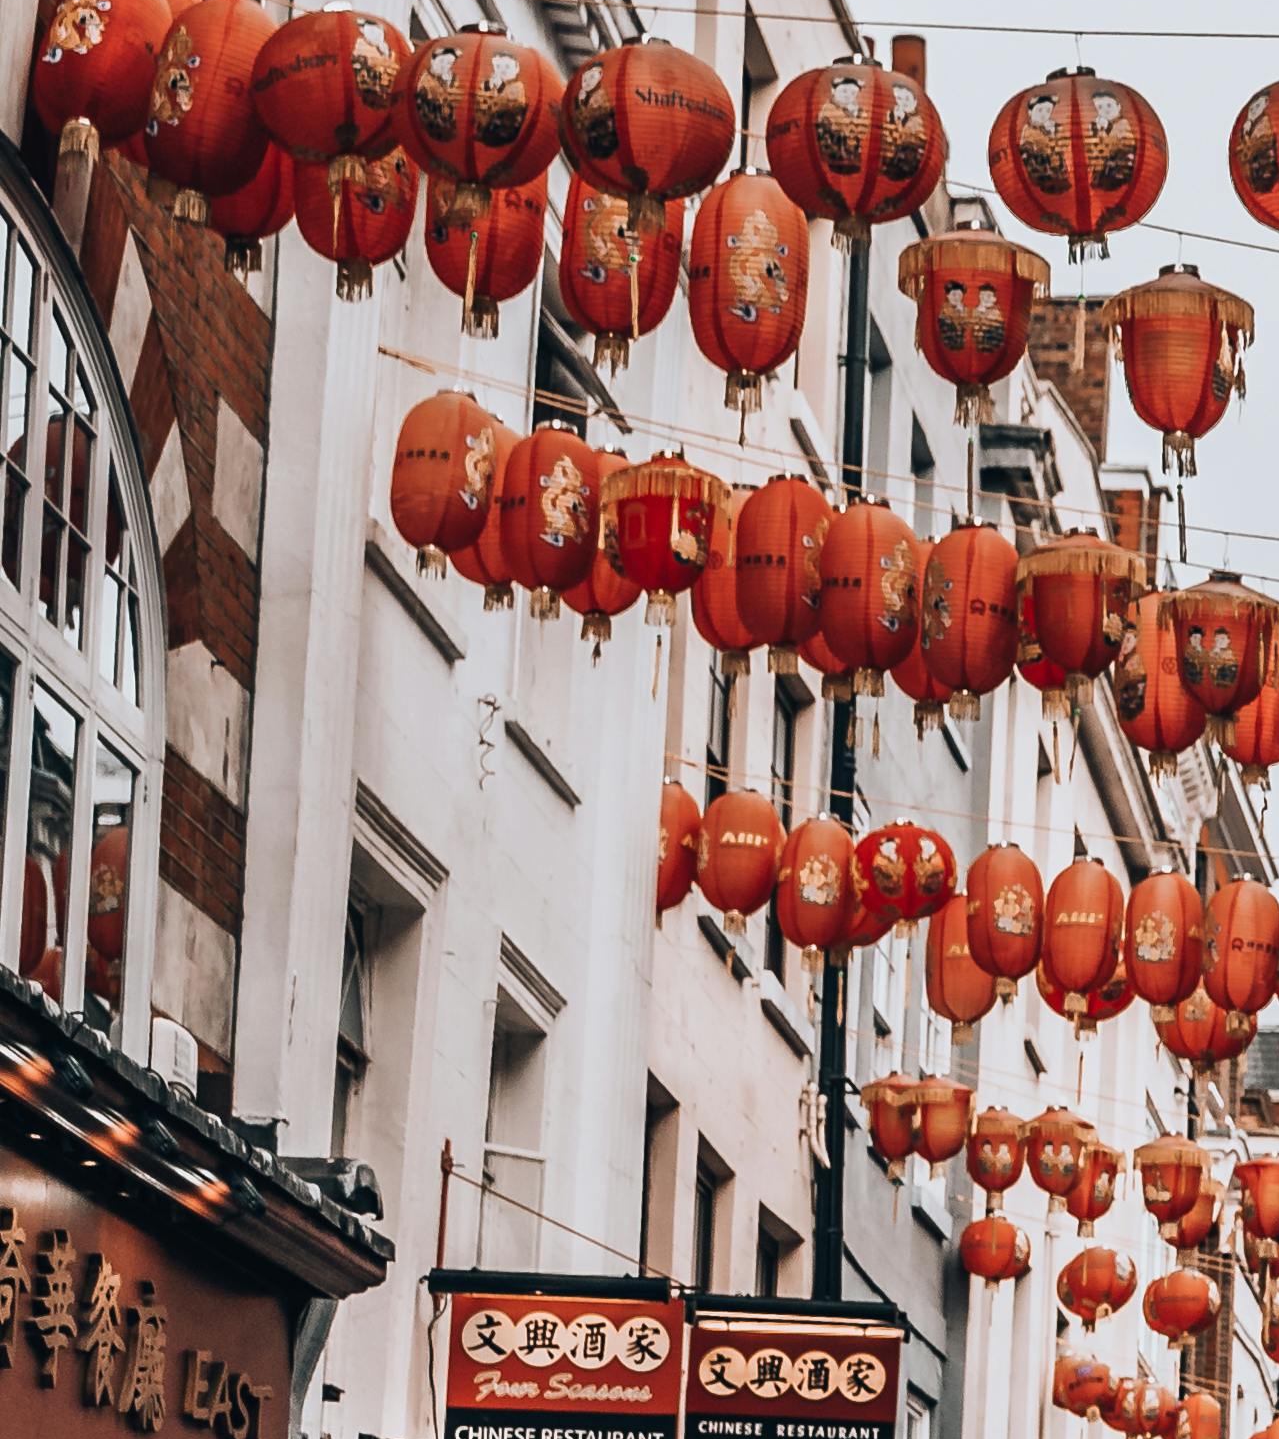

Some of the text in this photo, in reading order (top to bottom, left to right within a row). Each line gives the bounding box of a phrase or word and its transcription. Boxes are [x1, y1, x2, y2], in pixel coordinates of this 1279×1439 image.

[467, 1313, 662, 1365] 文興酒家
[473, 1369, 653, 1403] Four Seasons
[705, 1352, 878, 1397] 文興酒家
[698, 1420, 763, 1437] CHINESE
